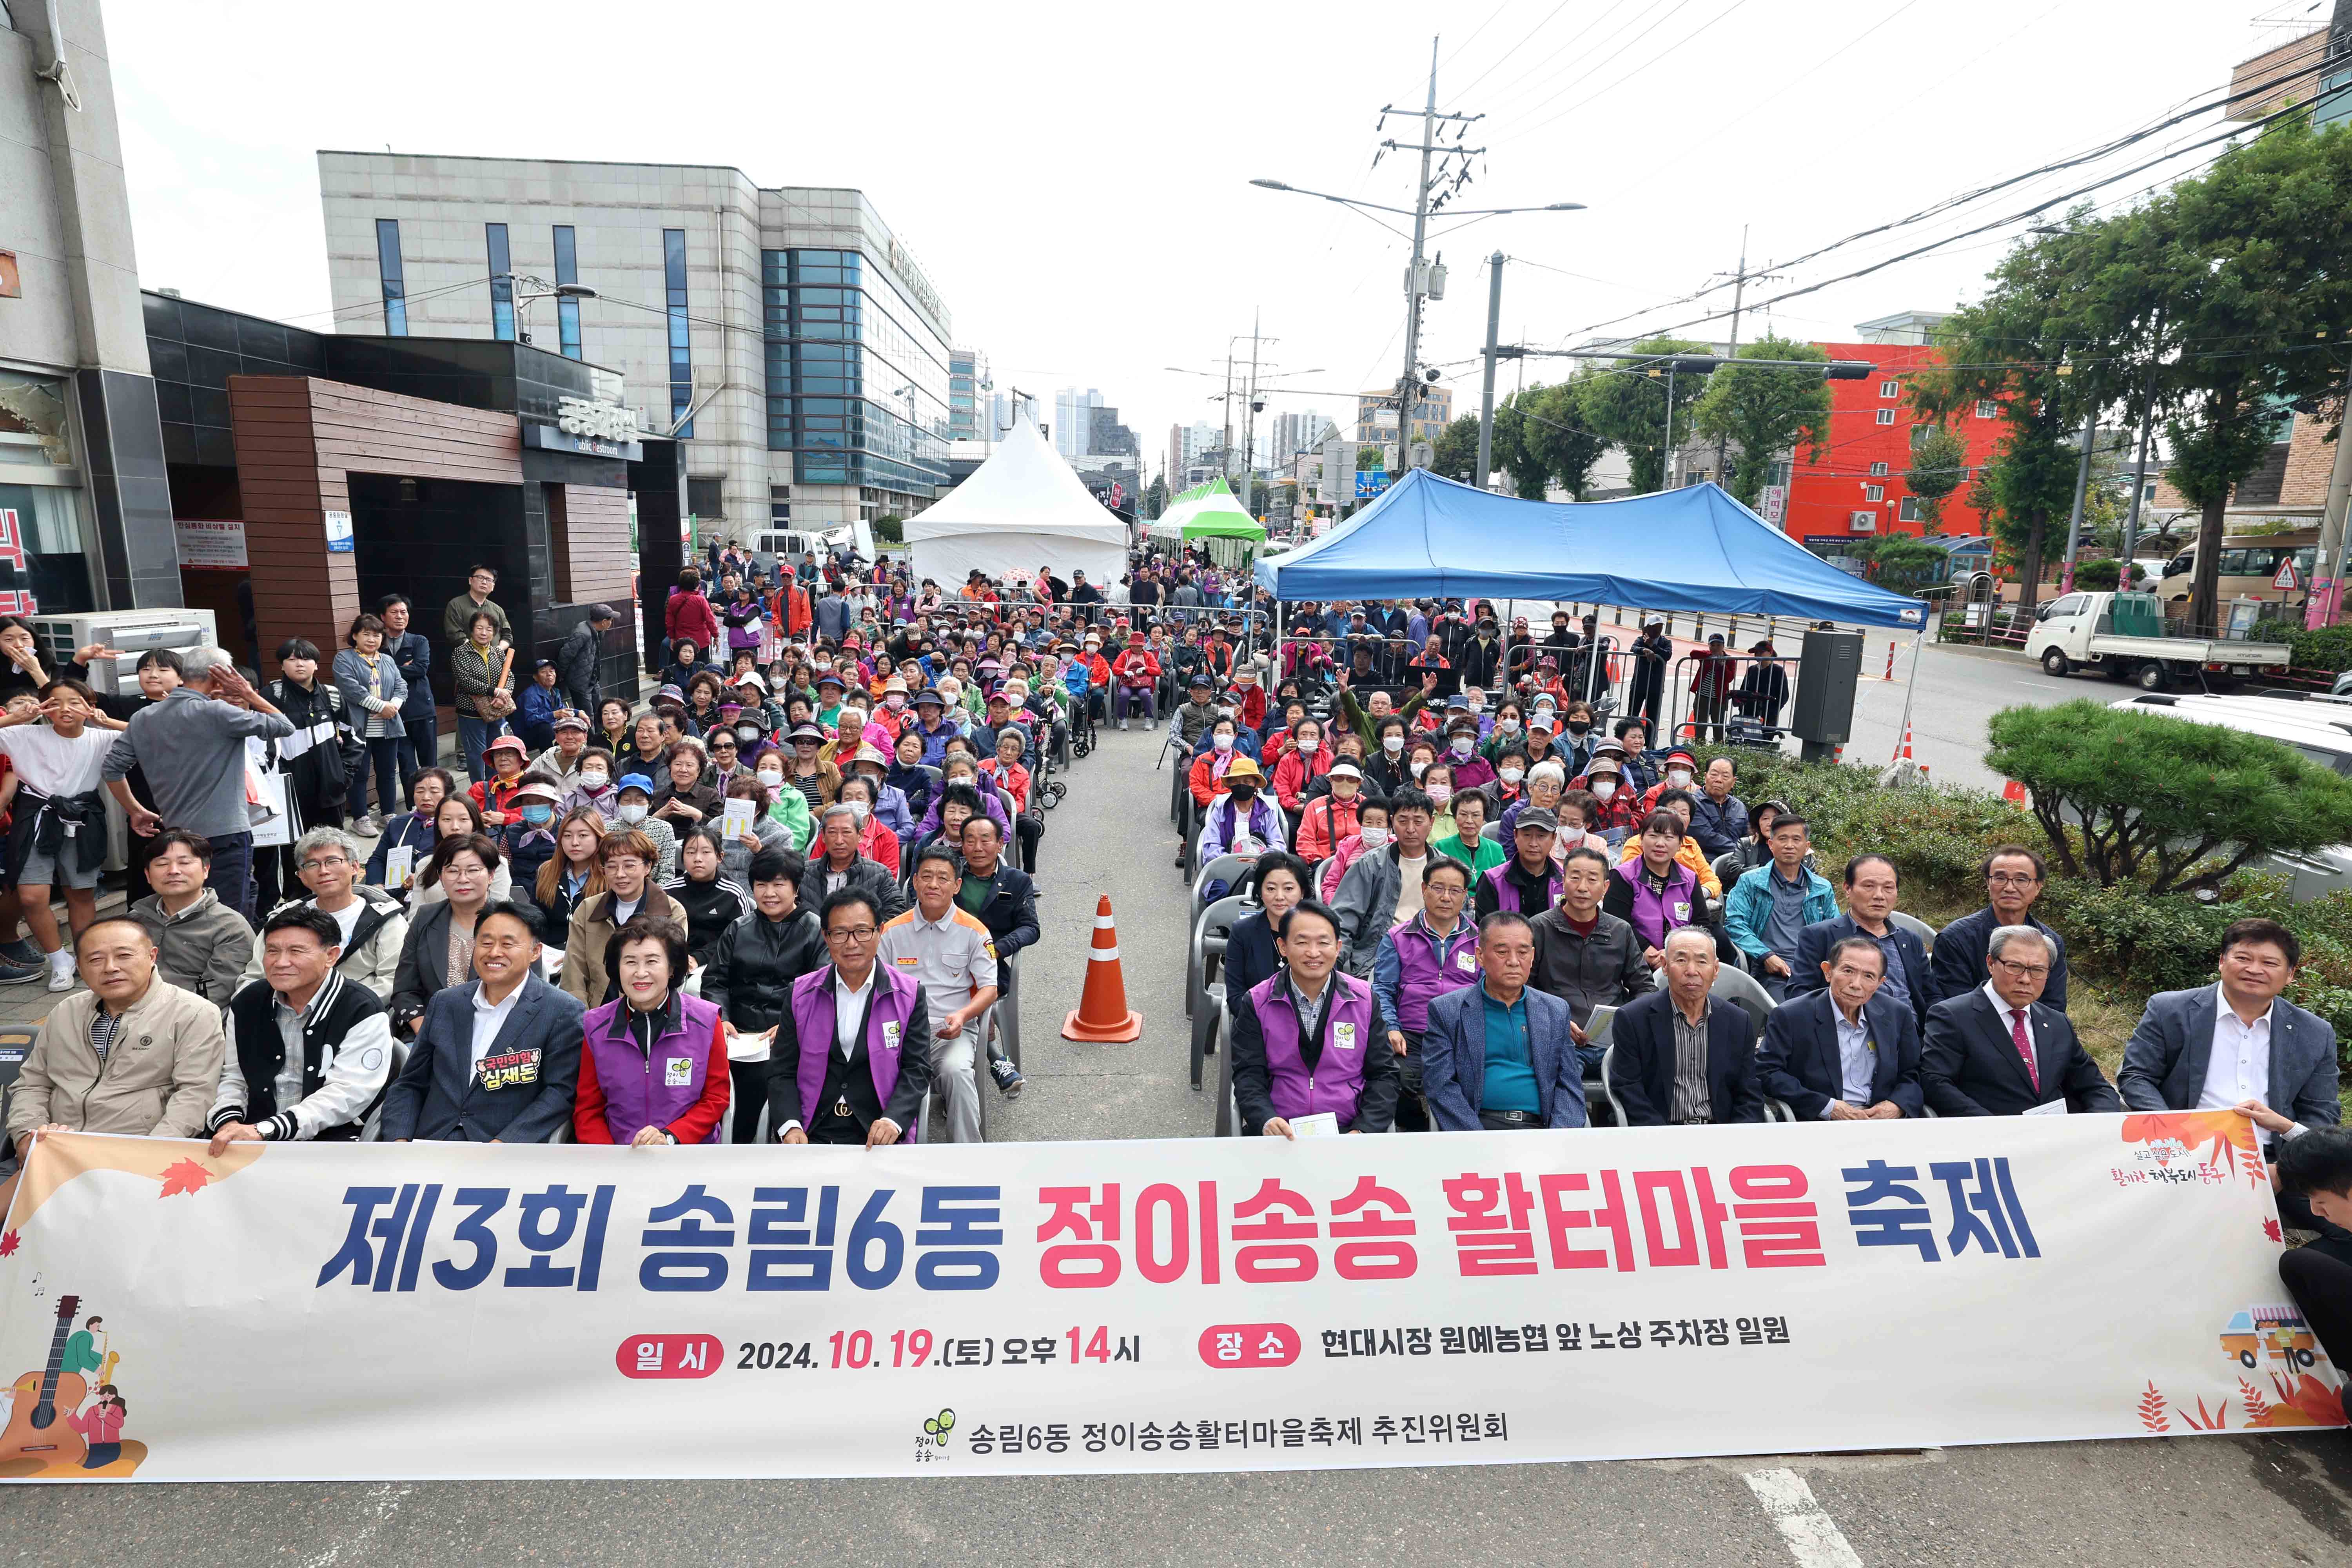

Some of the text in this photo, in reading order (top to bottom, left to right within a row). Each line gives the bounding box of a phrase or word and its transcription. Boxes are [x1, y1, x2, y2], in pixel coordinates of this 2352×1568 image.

[558, 396, 638, 444] 공중화장실
[575, 439, 617, 455] Public Restroom
[486, 1051, 531, 1069] 국민의힘
[483, 1063, 537, 1089] 심재돈
[2152, 1149, 2169, 1160] 싶은
[2170, 1149, 2192, 1158] 도시!
[2111, 1163, 2225, 1187] 활기찬 행복도시 동구
[318, 1158, 2041, 1292] 제3회 송림6동 정이송송 활터마을 축제
[1321, 1316, 1791, 1357] 현대시장 원예농협 앞 노상 주차장 일원
[737, 1343, 818, 1370] 2024.
[1002, 1338, 1057, 1365] 오후
[915, 1436, 933, 1447] 정이
[969, 1413, 1508, 1455] 송림6동 정이송송활터마을축제 추진위원회
[915, 1449, 933, 1462] 송송
